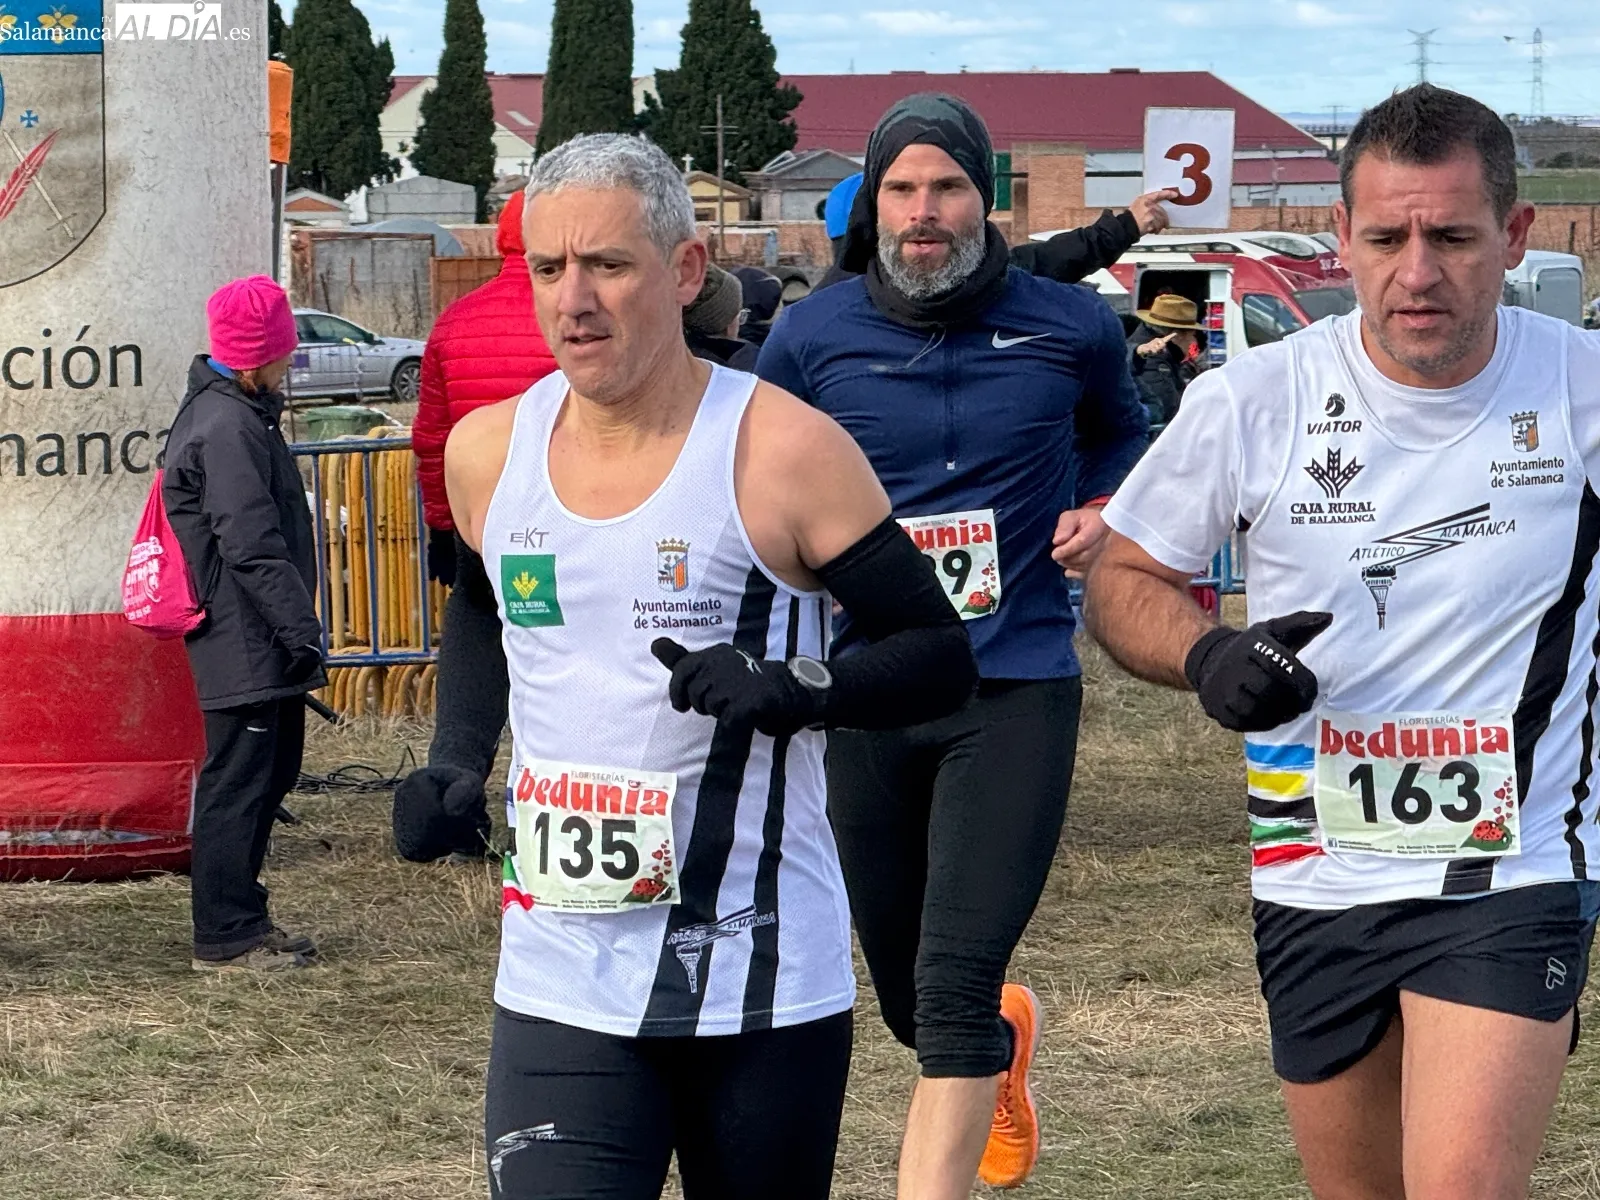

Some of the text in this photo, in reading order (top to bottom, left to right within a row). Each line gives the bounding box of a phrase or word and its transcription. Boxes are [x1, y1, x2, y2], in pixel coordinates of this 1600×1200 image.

[1162, 143, 1213, 206] 3
[2, 325, 143, 390] ción
[1307, 420, 1362, 435] VIATOR
[1490, 457, 1564, 475] Ayuntamiento
[1491, 473, 1564, 488] de Salamanca
[1291, 501, 1376, 514] CAJA RURAL
[1291, 514, 1376, 525] DE SALAMANCA
[510, 527, 550, 548] EKT
[901, 519, 993, 550] unia
[1349, 546, 1406, 562] ATLÉTICO
[922, 550, 972, 596] 9
[632, 598, 722, 615] Ayuntamiento
[634, 615, 723, 629] de Salamanca
[1253, 641, 1294, 674] KIPSTA
[1398, 715, 1460, 726] FLORISTERÍAS
[1319, 719, 1509, 759] bedunia
[570, 770, 625, 783] FLORISTERÍAS
[516, 767, 669, 816] bedunia
[1349, 760, 1482, 825] 163
[534, 811, 640, 880] 135
